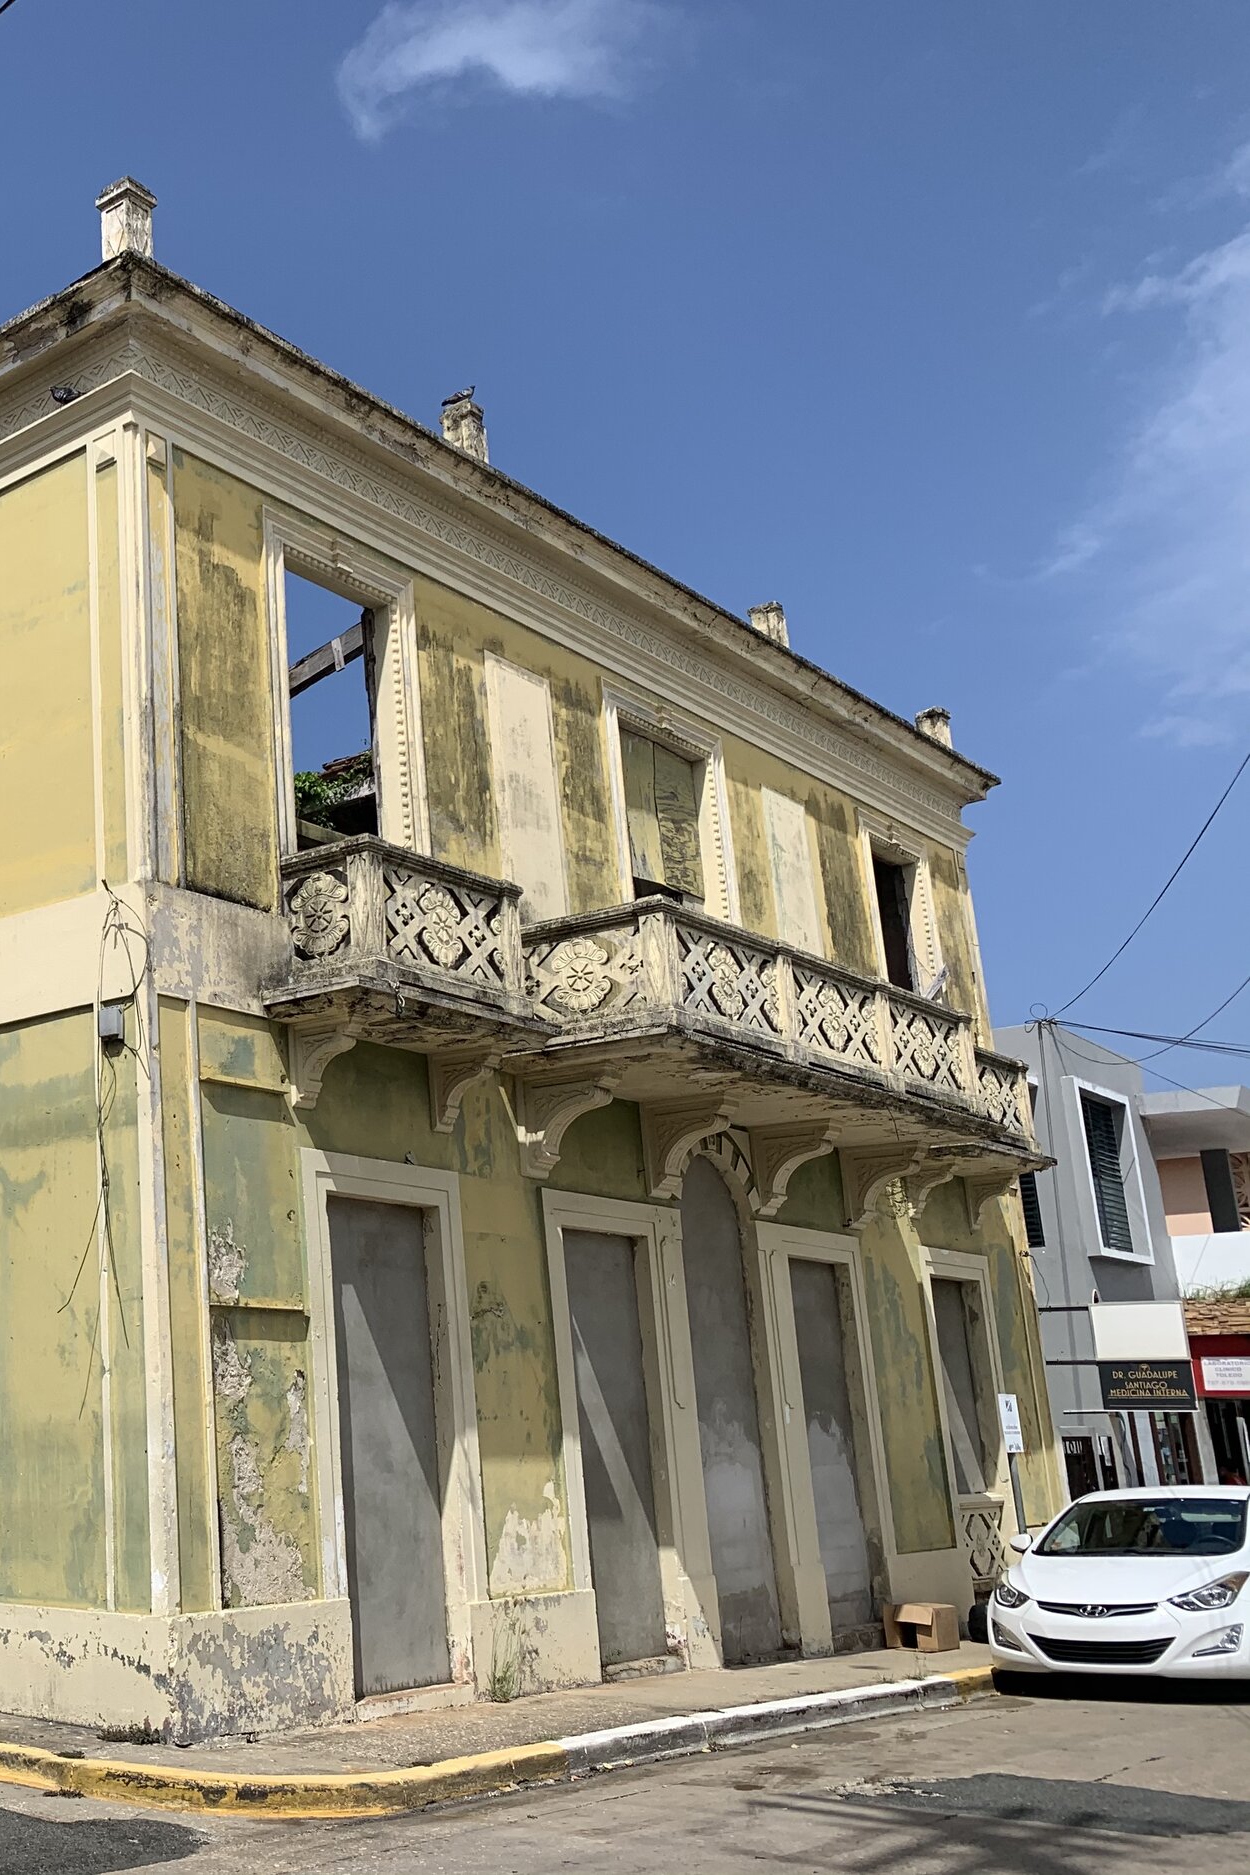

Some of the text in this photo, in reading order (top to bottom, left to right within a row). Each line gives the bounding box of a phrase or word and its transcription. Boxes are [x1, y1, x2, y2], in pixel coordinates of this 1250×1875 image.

[1112, 1371, 1178, 1379] DR. GUADALUPE
[1125, 1381, 1168, 1389] SANTIAGO
[1110, 1389, 1189, 1397] MEDICINA INTERNA
